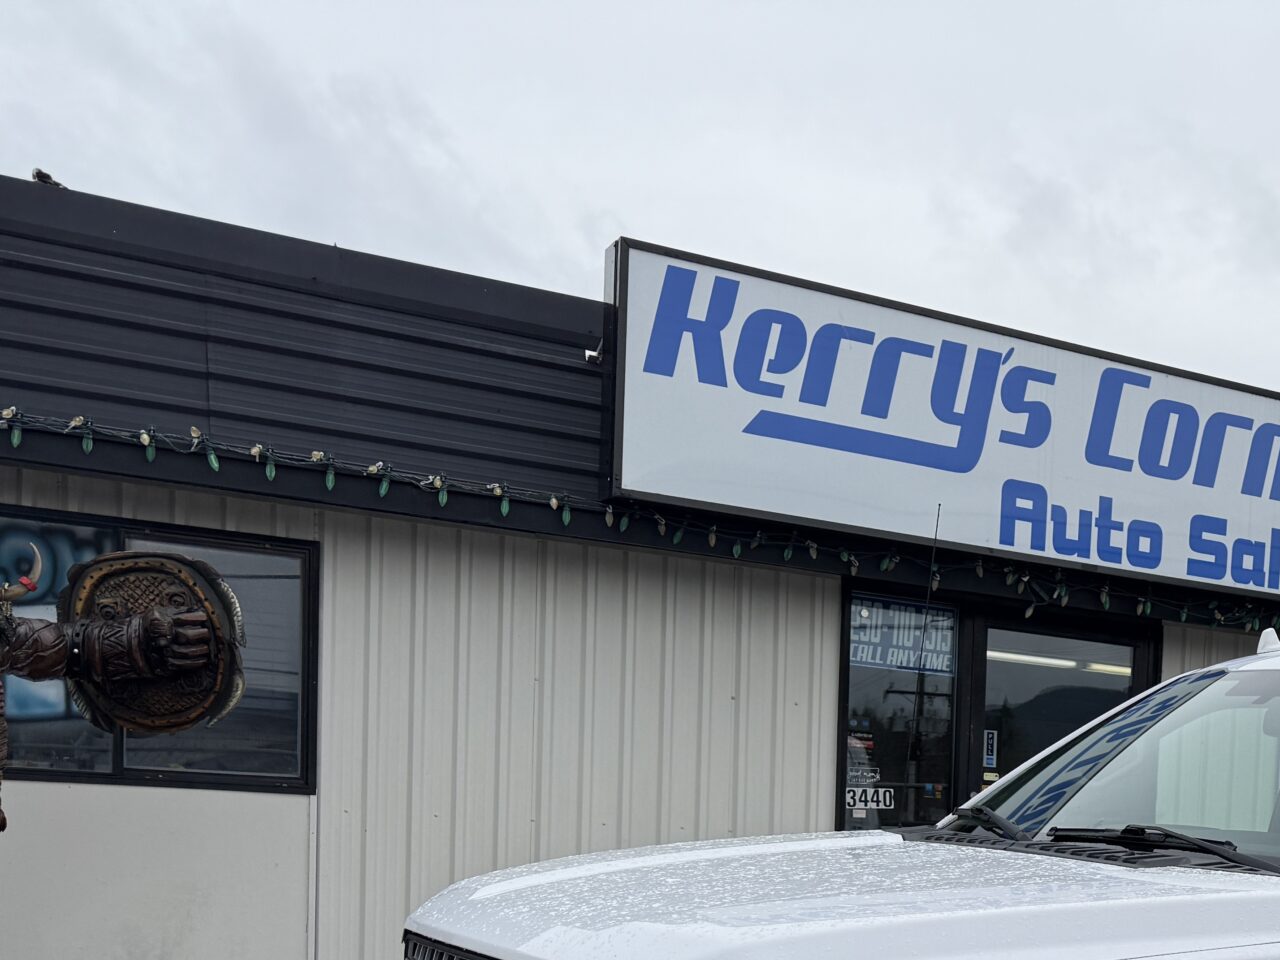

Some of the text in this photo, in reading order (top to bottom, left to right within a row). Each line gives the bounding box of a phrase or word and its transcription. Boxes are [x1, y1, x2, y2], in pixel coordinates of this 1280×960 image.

[643, 265, 1056, 474] Kerry's
[1000, 479, 1162, 569] Auto
[850, 643, 883, 664] CALL
[846, 789, 893, 808] 3440
